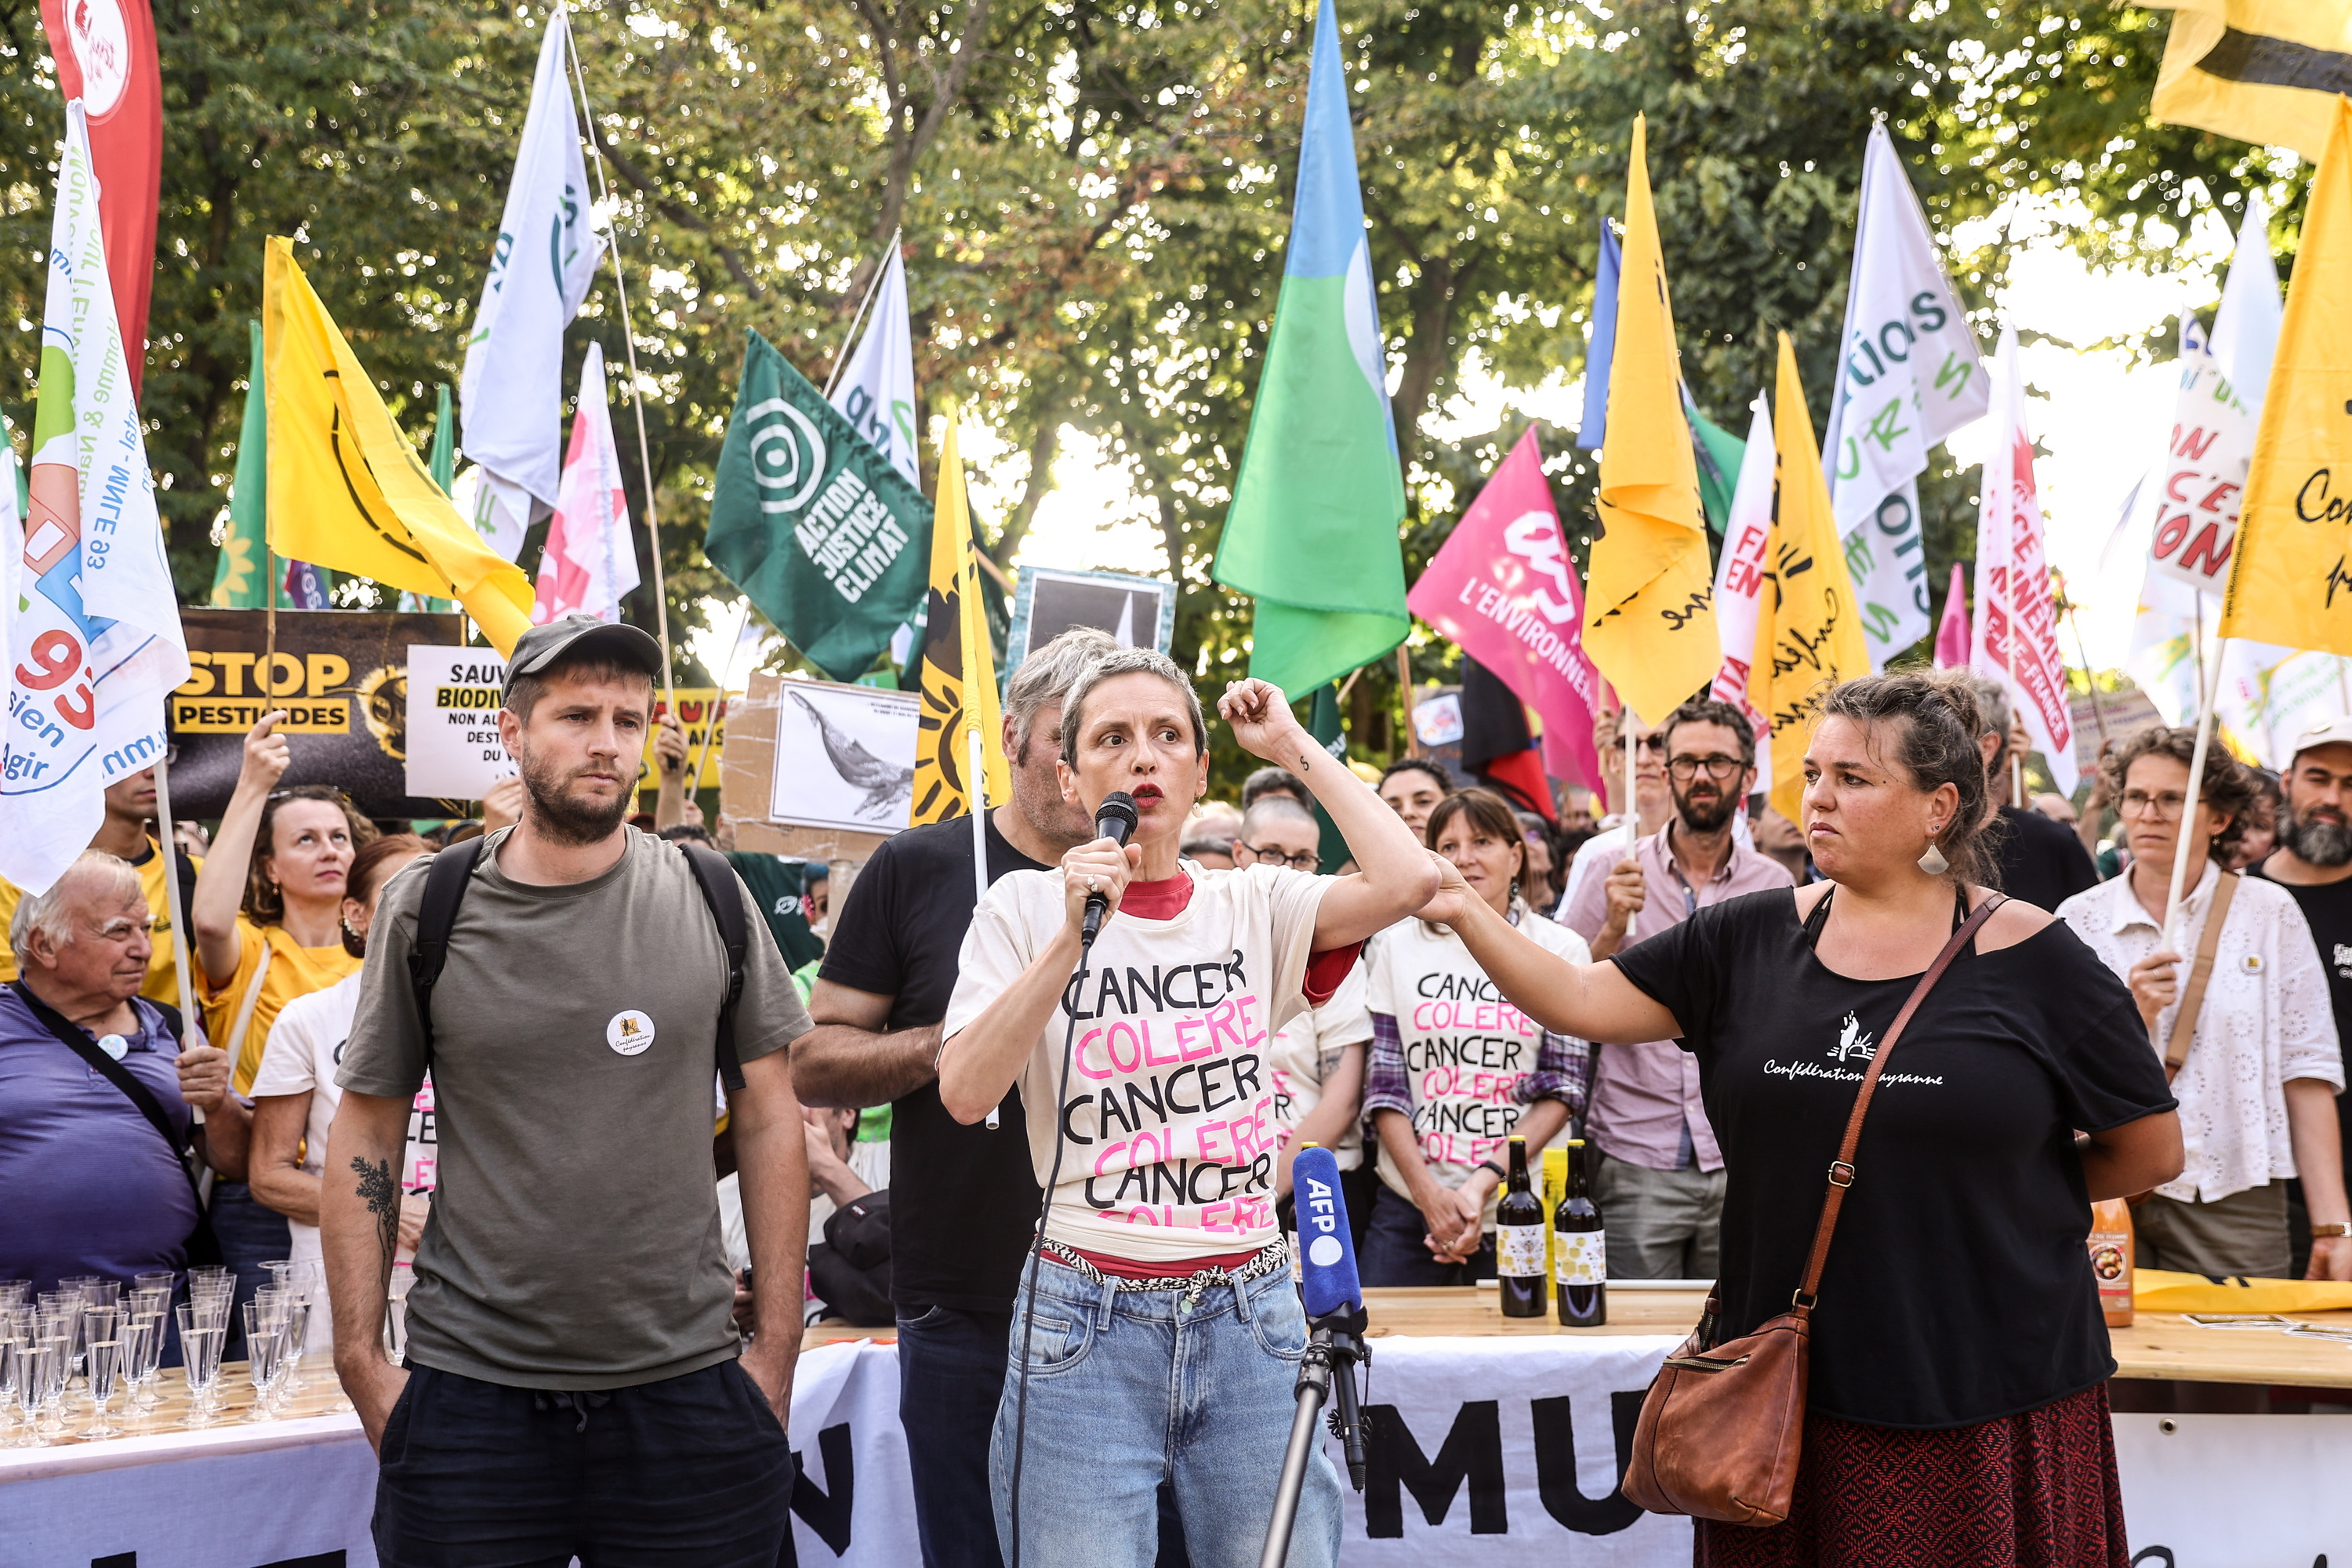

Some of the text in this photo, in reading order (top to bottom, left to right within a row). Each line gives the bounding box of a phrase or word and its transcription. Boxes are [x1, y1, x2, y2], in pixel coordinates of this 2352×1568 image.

[794, 466, 867, 559] ACTION
[812, 489, 889, 581] JUSTICE
[833, 514, 909, 604] CLIMAT
[174, 650, 350, 697] STOP
[180, 706, 345, 724] PESTIIDES
[448, 713, 476, 726] NON
[483, 750, 501, 761] DU
[1061, 949, 1247, 1020] CANCER
[1074, 994, 1268, 1080] COLÈRE
[1407, 1035, 1523, 1072] CANCER
[1062, 1054, 1260, 1145] CANCER
[1763, 1058, 1944, 1088] Confédération aysanne
[1306, 1177, 1336, 1232] AFP
